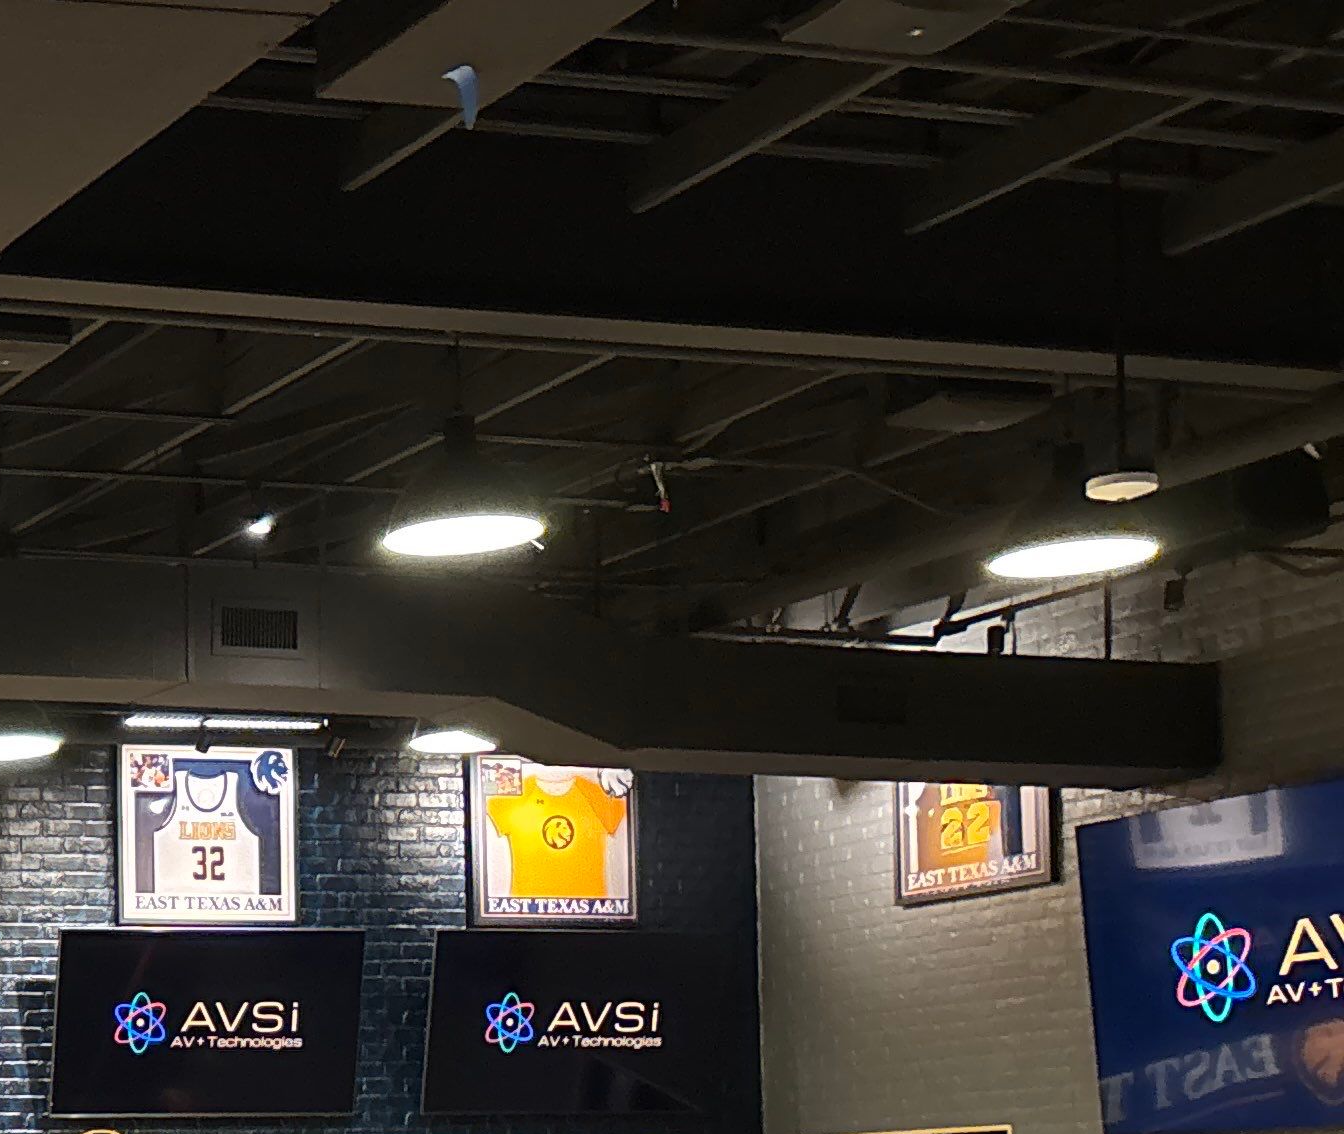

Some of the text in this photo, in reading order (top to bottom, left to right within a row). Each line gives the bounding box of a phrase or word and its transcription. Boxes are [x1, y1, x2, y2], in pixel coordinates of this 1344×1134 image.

[939, 800, 991, 850] 22
[191, 846, 226, 881] 32
[907, 868, 945, 890] EAST
[947, 860, 999, 883] TEXAS
[135, 895, 283, 912] EAST TEXAS A&M
[488, 898, 630, 914] EAST TEXAS A&M
[180, 1001, 300, 1033] AVSi
[546, 1001, 660, 1033] AVSi
